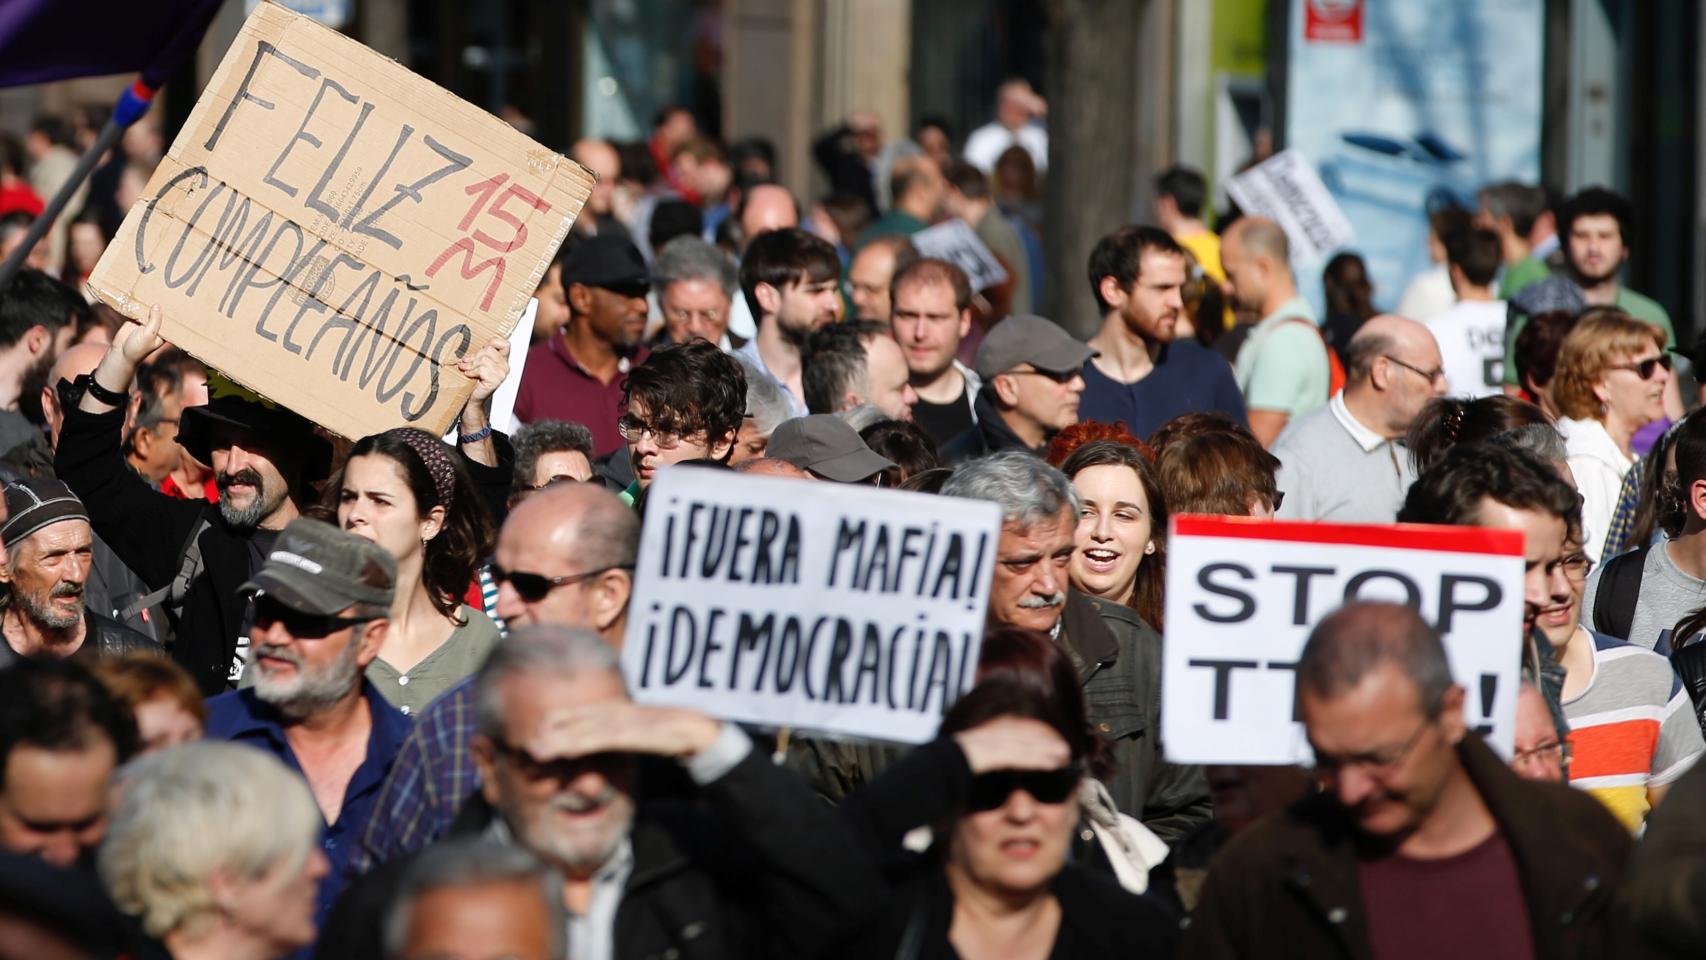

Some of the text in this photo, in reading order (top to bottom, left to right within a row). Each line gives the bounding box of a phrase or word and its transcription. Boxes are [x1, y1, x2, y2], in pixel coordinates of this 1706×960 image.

[203, 40, 473, 250] FELIZ
[457, 172, 552, 252] 15
[135, 166, 471, 422] COMPLEAÑOS
[425, 237, 506, 312] M
[661, 497, 803, 585] ¡FUERA
[1191, 562, 1503, 633] STOP
